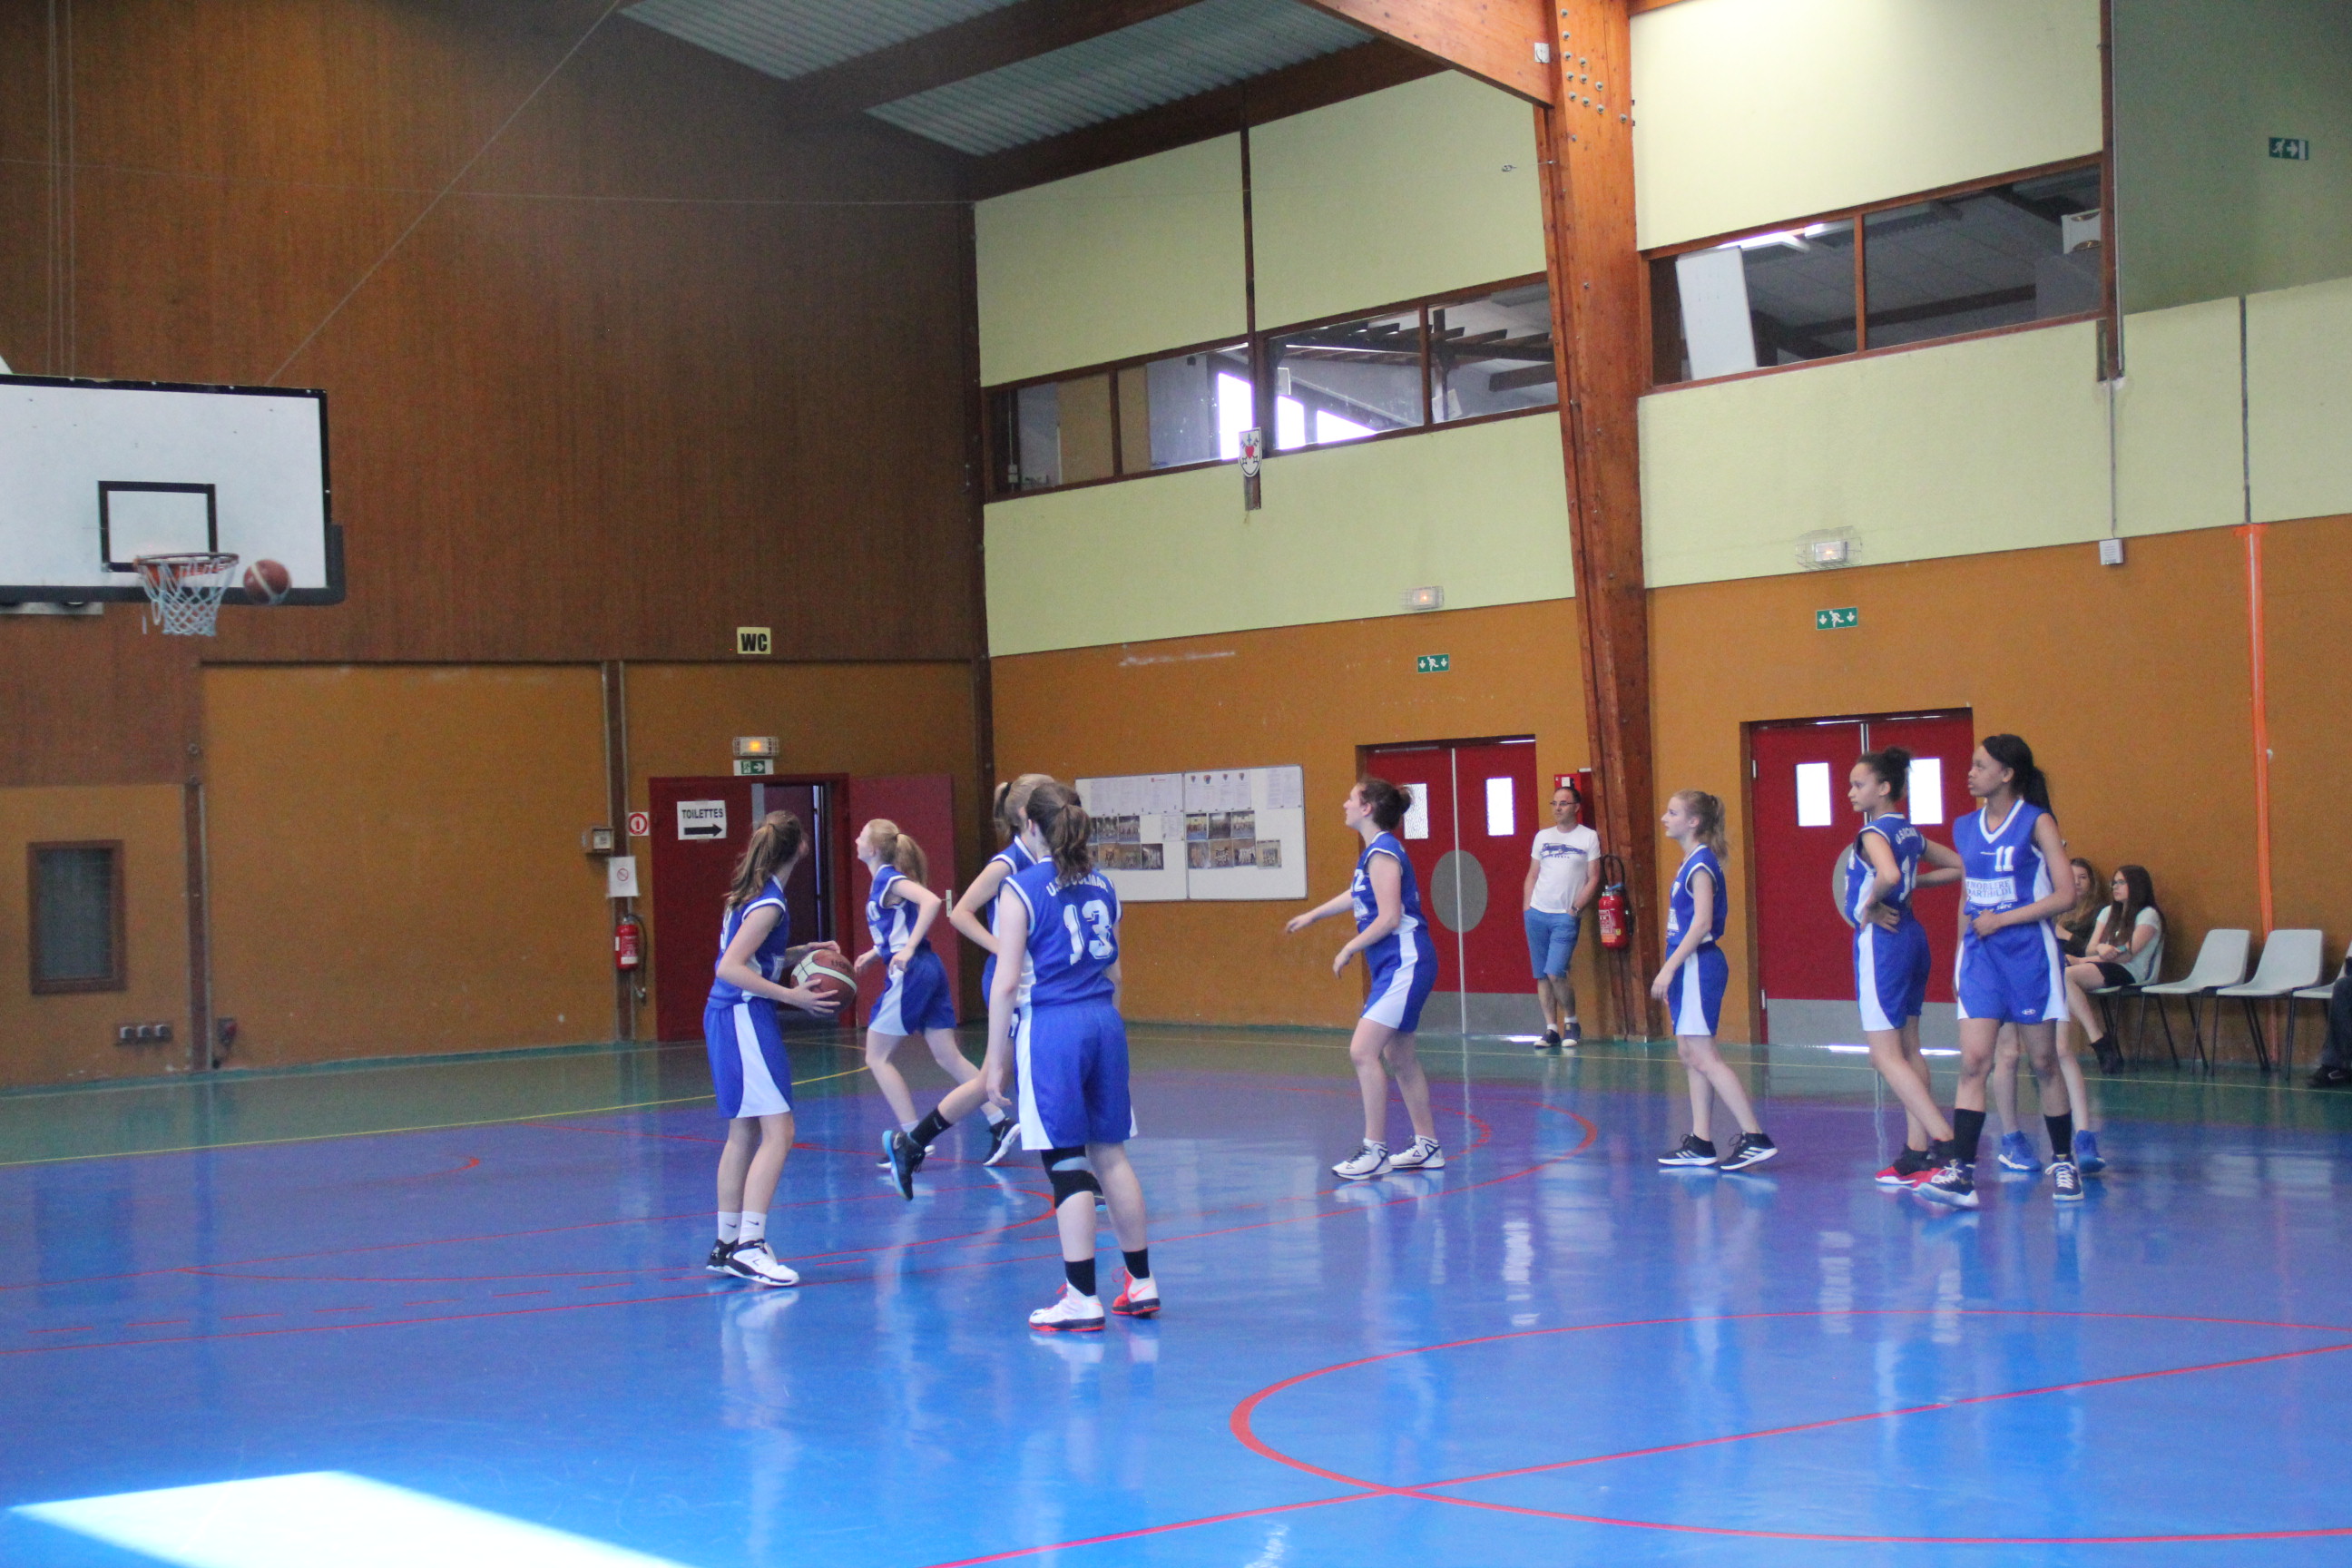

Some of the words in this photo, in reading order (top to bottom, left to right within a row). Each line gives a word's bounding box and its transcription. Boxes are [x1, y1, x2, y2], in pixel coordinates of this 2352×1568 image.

[740, 632, 768, 652] WC
[681, 808, 724, 818] TOILETTES
[1994, 846, 2014, 872] 11
[1063, 899, 1114, 965] 13
